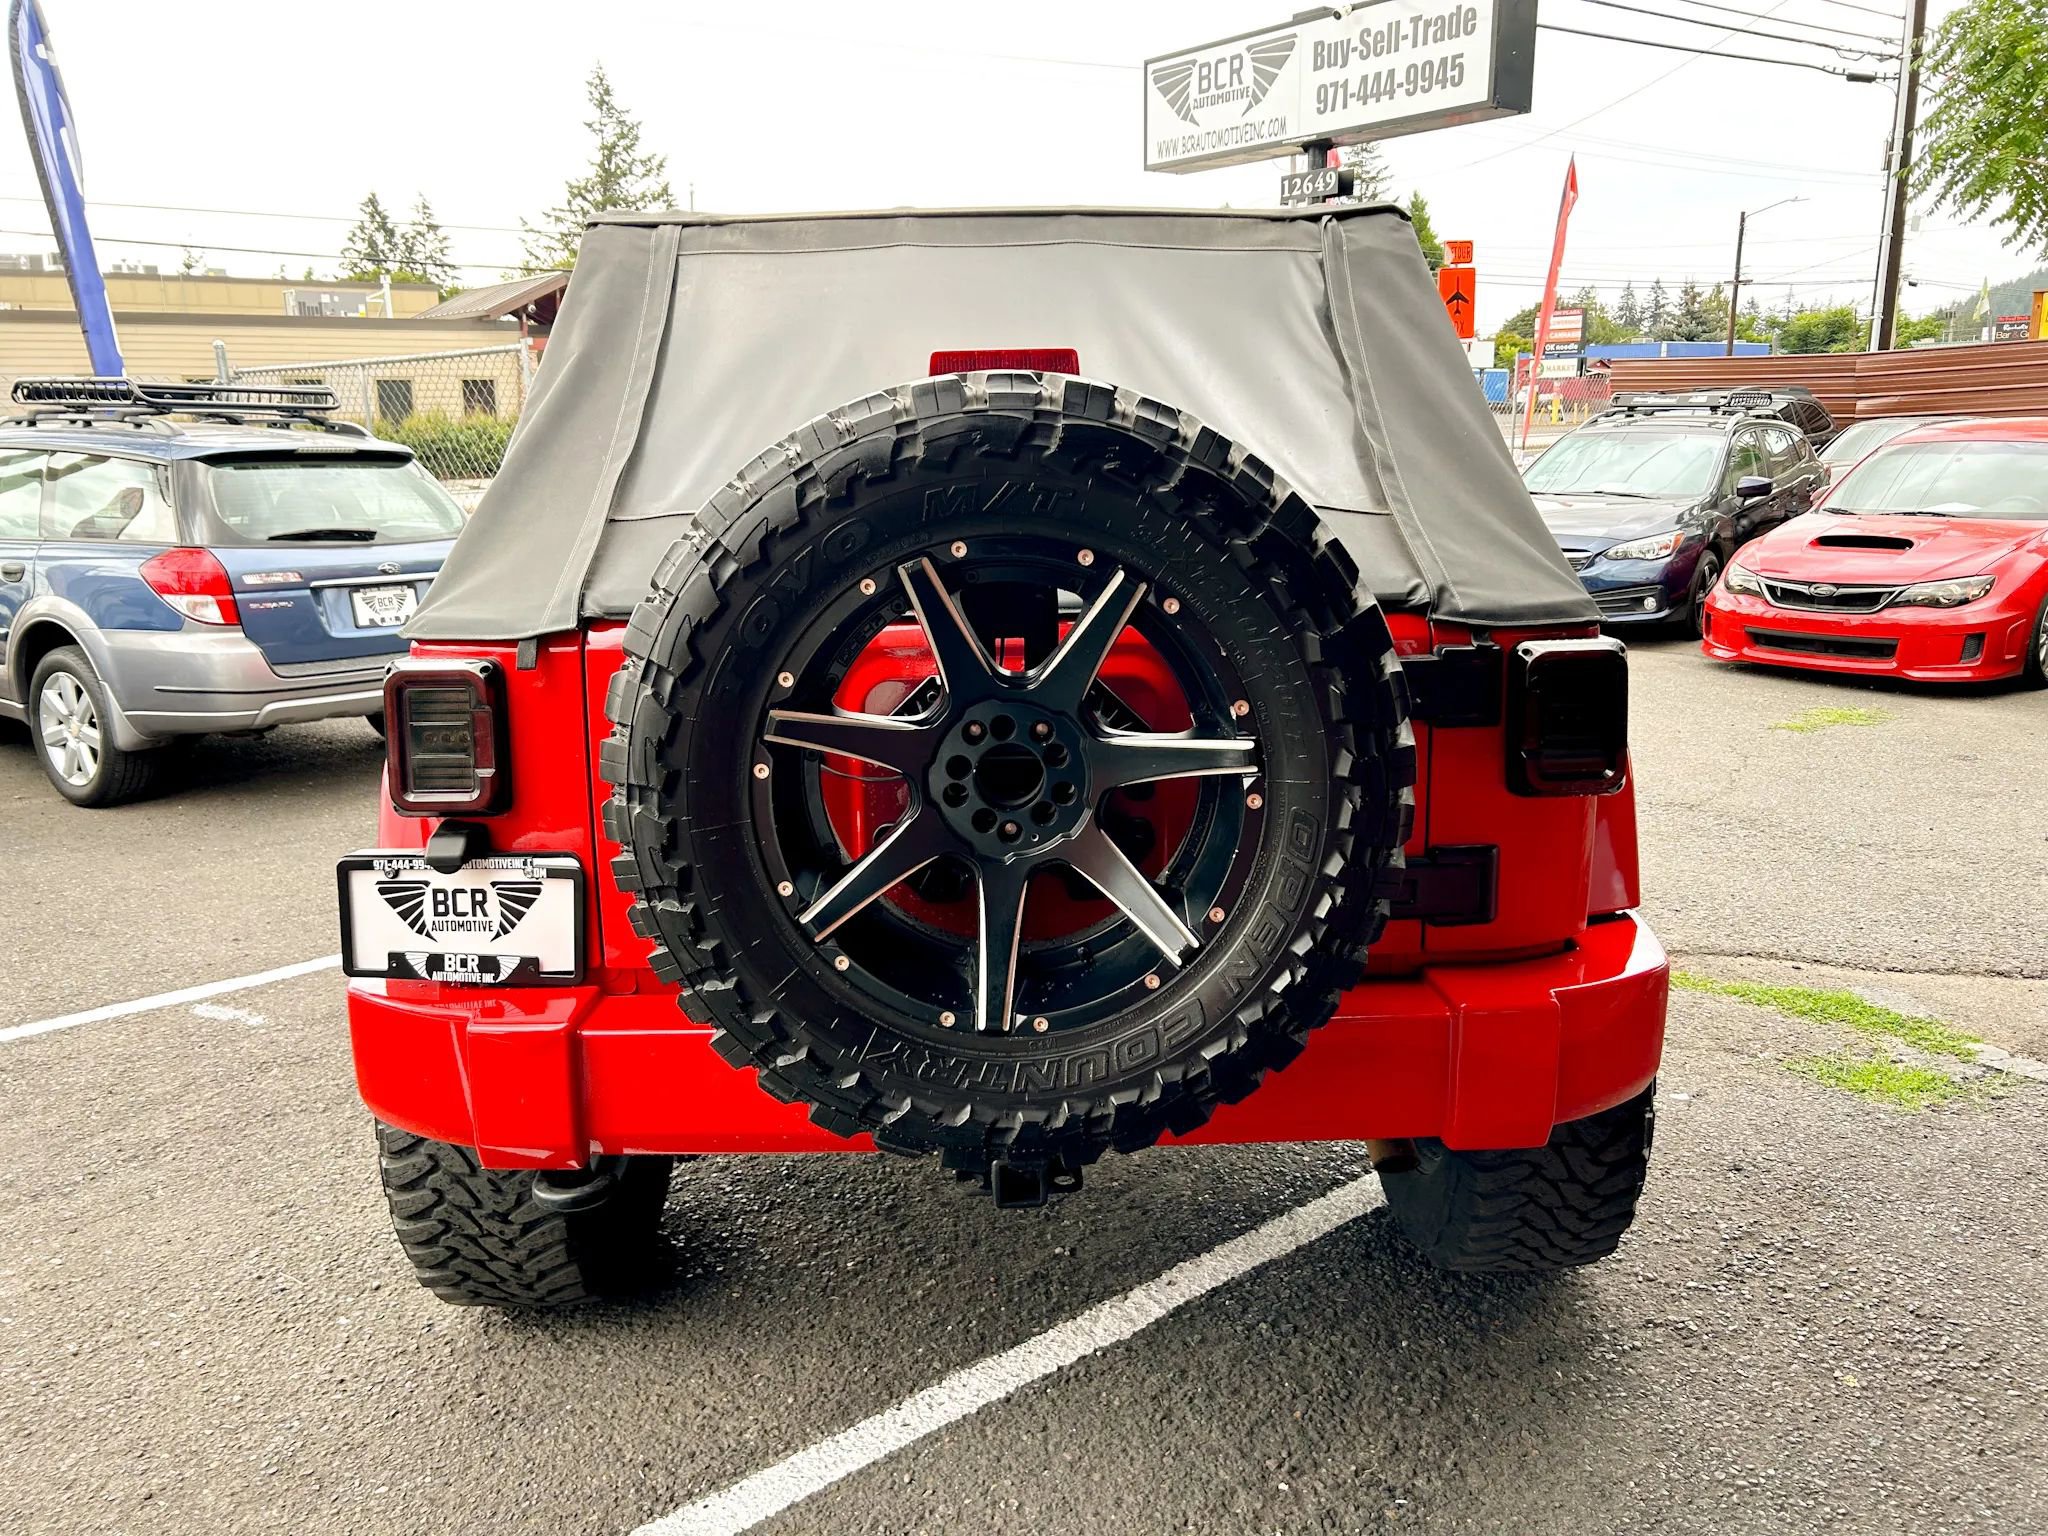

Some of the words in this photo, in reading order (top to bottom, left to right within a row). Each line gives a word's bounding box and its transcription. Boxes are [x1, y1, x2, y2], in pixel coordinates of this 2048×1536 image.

[1313, 4, 1477, 72] Buy-Sell-Trade
[1198, 53, 1244, 94] BCR
[1316, 53, 1465, 116] 971-444-9945
[1193, 85, 1251, 110] AUTOMOTIVE
[1157, 116, 1287, 159] WWW.BCRAUTOMOTIVEINC.COM
[1282, 172, 1337, 198] 12649
[1556, 343, 1578, 351] noodle
[1996, 331, 2011, 339] Bar
[1546, 364, 1577, 372] MARKET
[377, 596, 394, 608] BCR
[432, 888, 489, 917] BCR
[1216, 806, 1320, 999] OPEN
[431, 920, 493, 932] AUTOMOTIVE
[444, 953, 479, 972] BCR
[431, 971, 481, 983] AUTOMOTIVE
[482, 972, 496, 983] INC
[866, 997, 1206, 1094] COUNTRY
